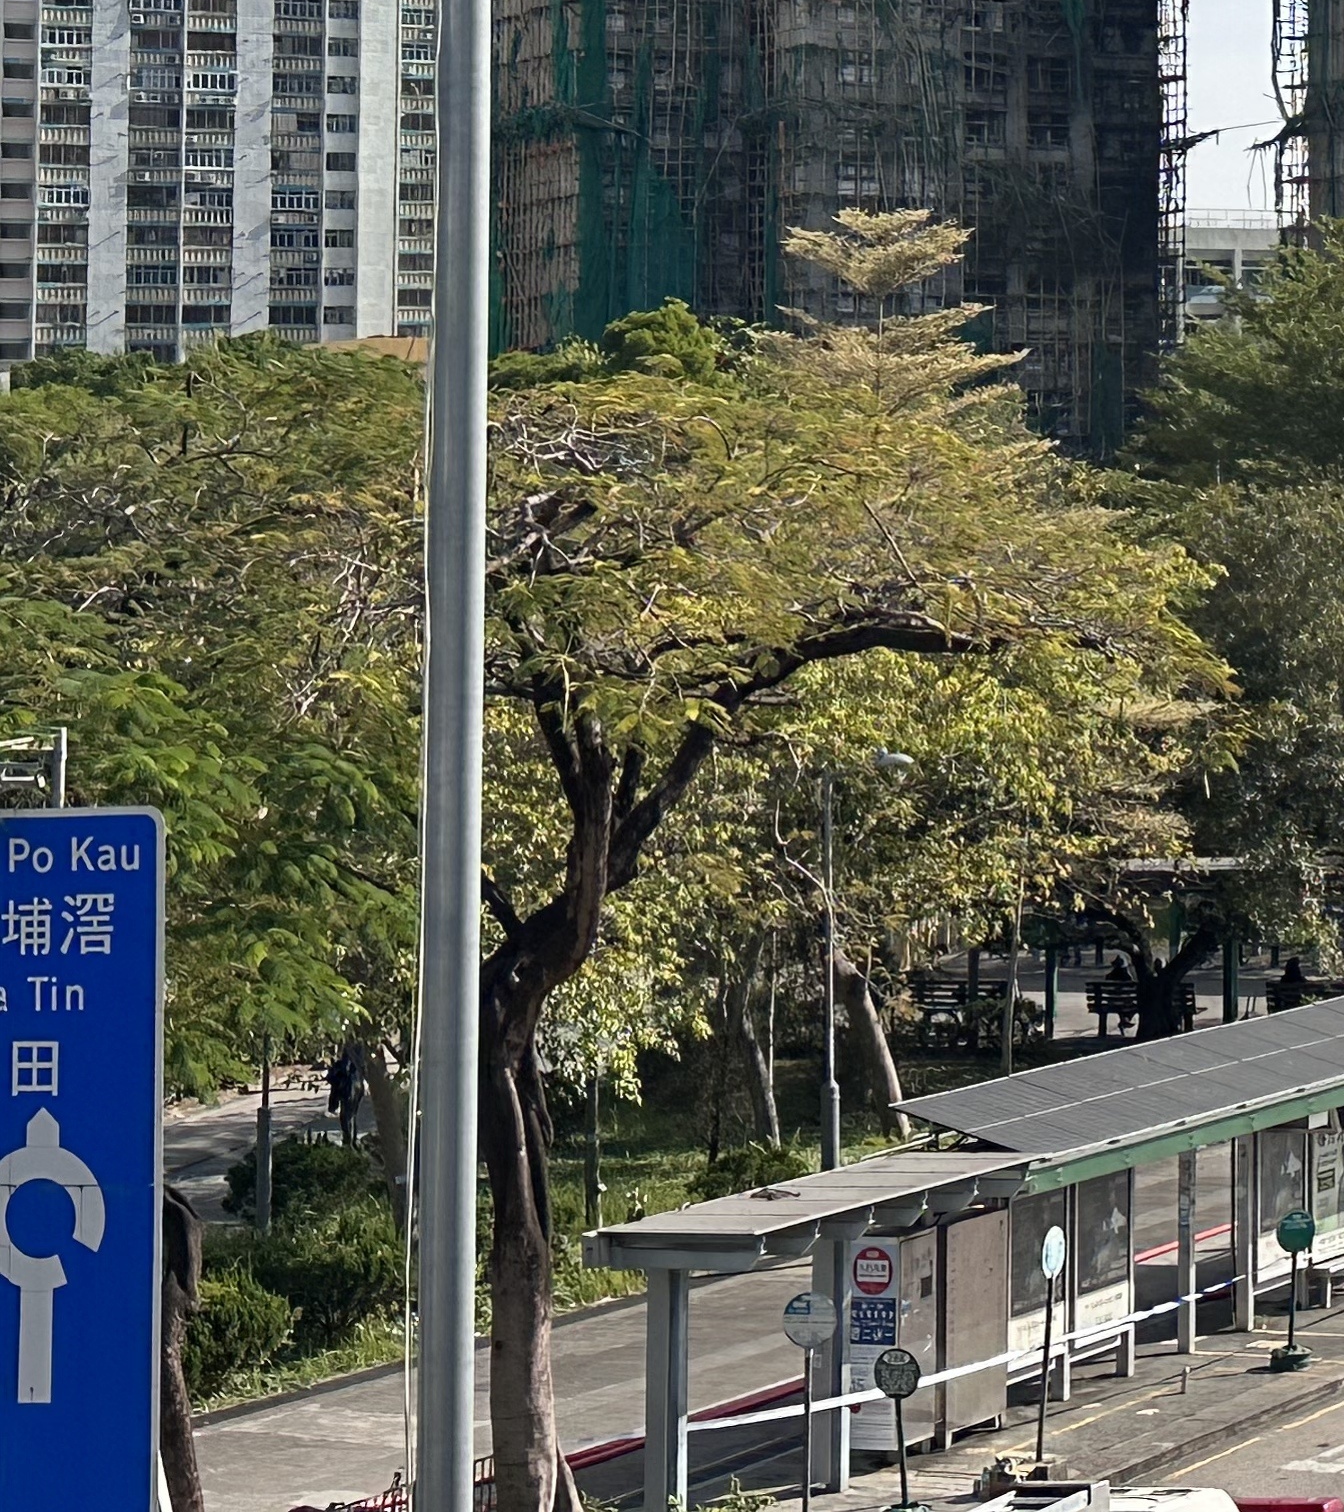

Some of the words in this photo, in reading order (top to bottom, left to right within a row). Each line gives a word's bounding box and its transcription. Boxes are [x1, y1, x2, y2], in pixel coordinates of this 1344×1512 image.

[8, 838, 54, 874] Po
[71, 836, 140, 872] Kau
[27, 975, 85, 1012] Tin
[11, 1040, 60, 1097] 田
